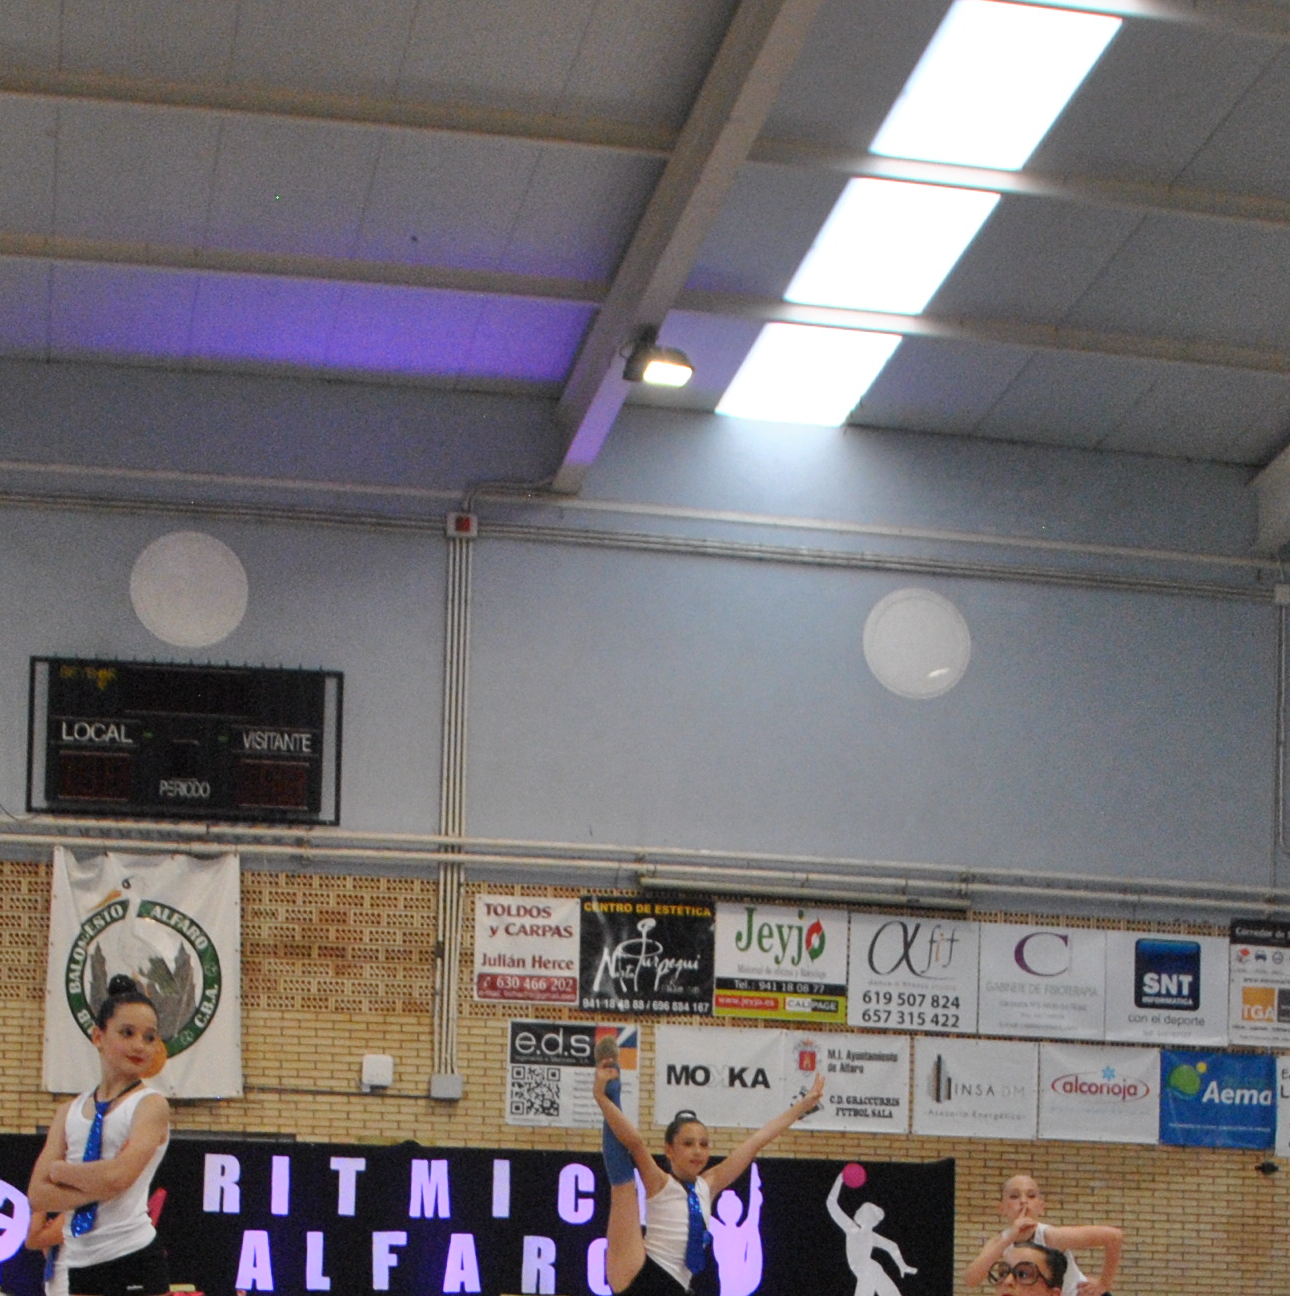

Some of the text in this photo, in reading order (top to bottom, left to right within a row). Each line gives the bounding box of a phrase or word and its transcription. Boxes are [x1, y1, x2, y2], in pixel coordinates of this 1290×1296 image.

[61, 722, 133, 743] LOCAL
[242, 731, 311, 751] VISITANTE
[159, 780, 210, 797] PERIODO
[485, 903, 552, 919] TOLDOS
[584, 902, 632, 914] CENTRO
[636, 903, 650, 914] DE
[150, 905, 208, 950] ALFARO
[490, 922, 574, 939] y CARPAS
[531, 955, 575, 970] Herce
[497, 976, 573, 992] 630 466 202
[758, 981, 777, 991] 941
[782, 983, 794, 992] 18
[812, 984, 825, 994] 77
[1029, 983, 1041, 994] DE
[1142, 972, 1193, 996] SNT
[583, 998, 599, 1009] 941
[862, 990, 960, 1009] 619 507 824
[862, 1009, 960, 1028] 657 315 422
[1128, 1014, 1149, 1024] con
[1164, 1014, 1205, 1027] deporte
[515, 1027, 591, 1057] e.d.s
[846, 1050, 898, 1062] Ayuntamiento
[827, 1063, 864, 1074] de Alfaro
[1202, 1080, 1273, 1105] Aema
[203, 1153, 646, 1225] RITMIC
[235, 1229, 612, 1296] ALFARO
